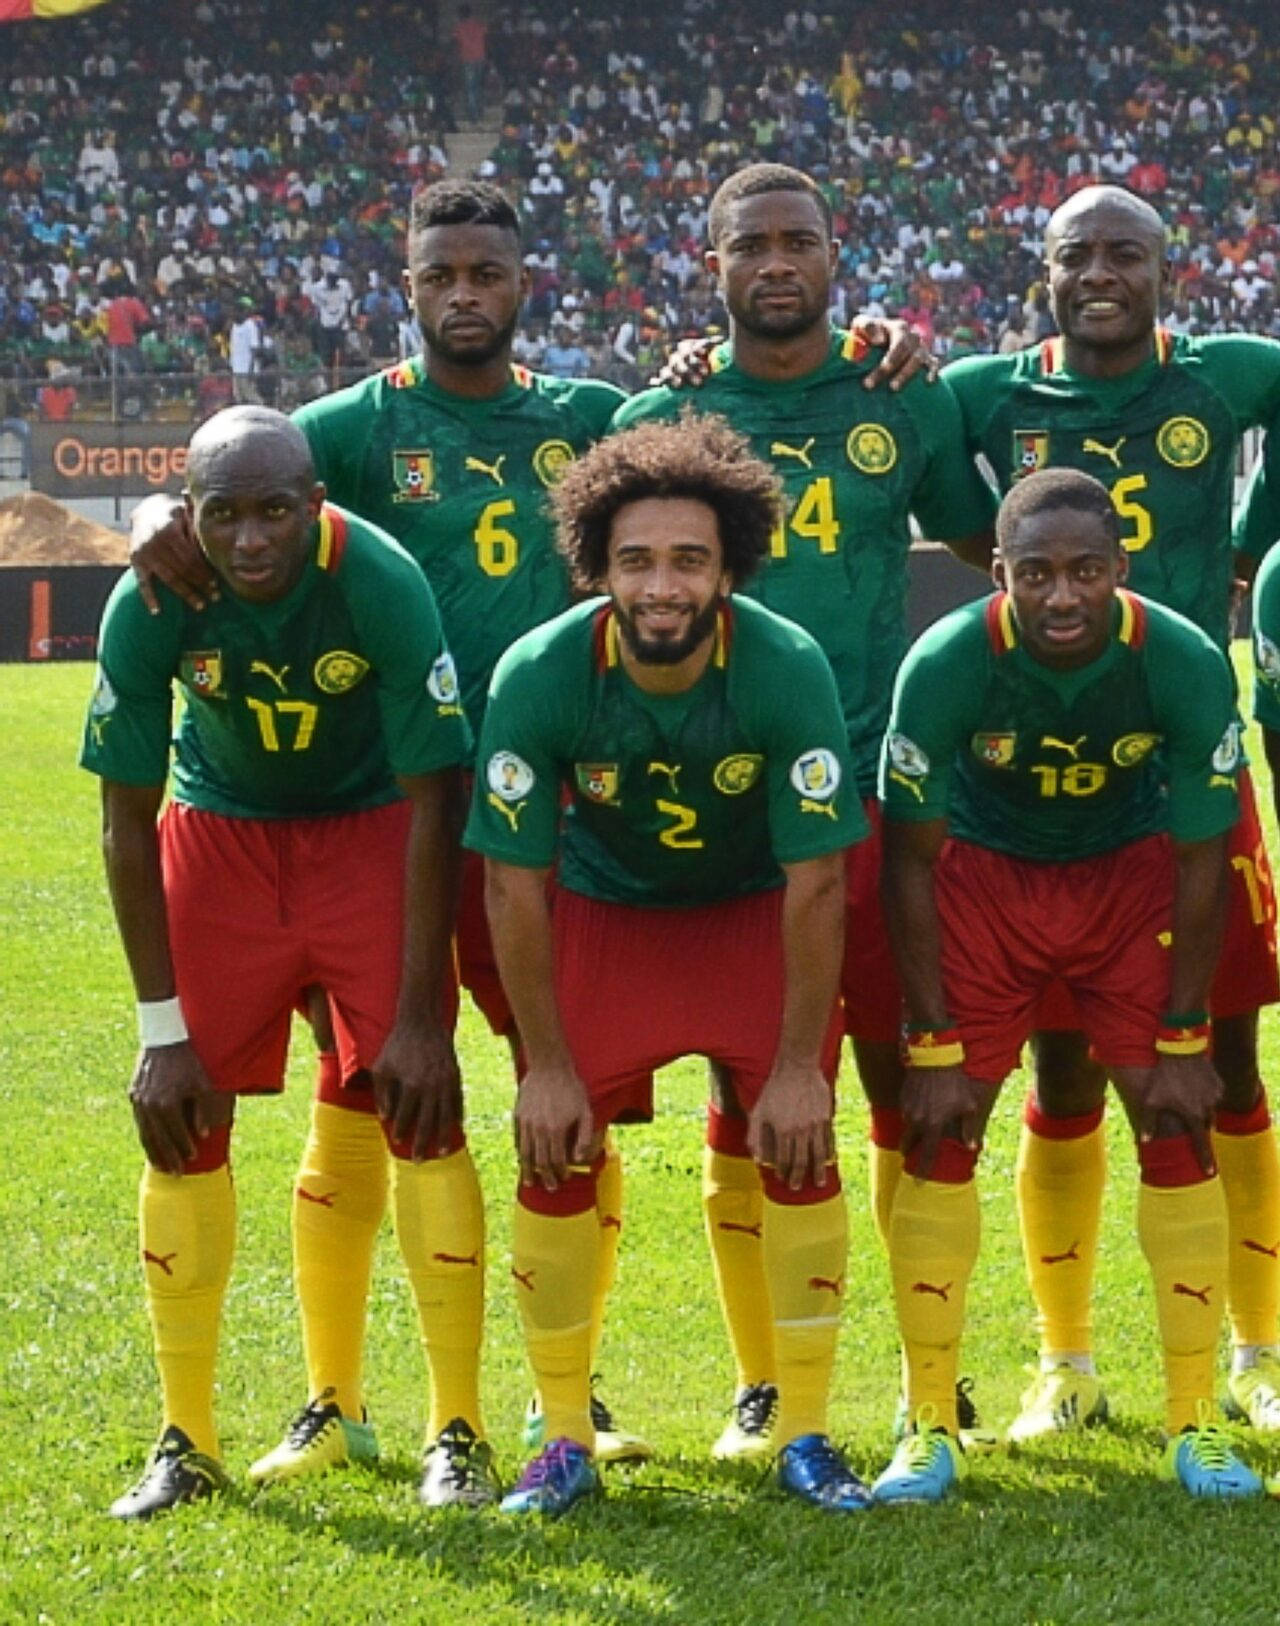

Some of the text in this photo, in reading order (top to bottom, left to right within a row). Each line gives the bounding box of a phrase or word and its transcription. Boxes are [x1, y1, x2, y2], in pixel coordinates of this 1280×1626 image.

[54, 437, 188, 483] Orange
[475, 499, 517, 576] 6
[246, 697, 318, 751] 17
[1032, 763, 1108, 796] 18
[656, 800, 703, 848] 2
